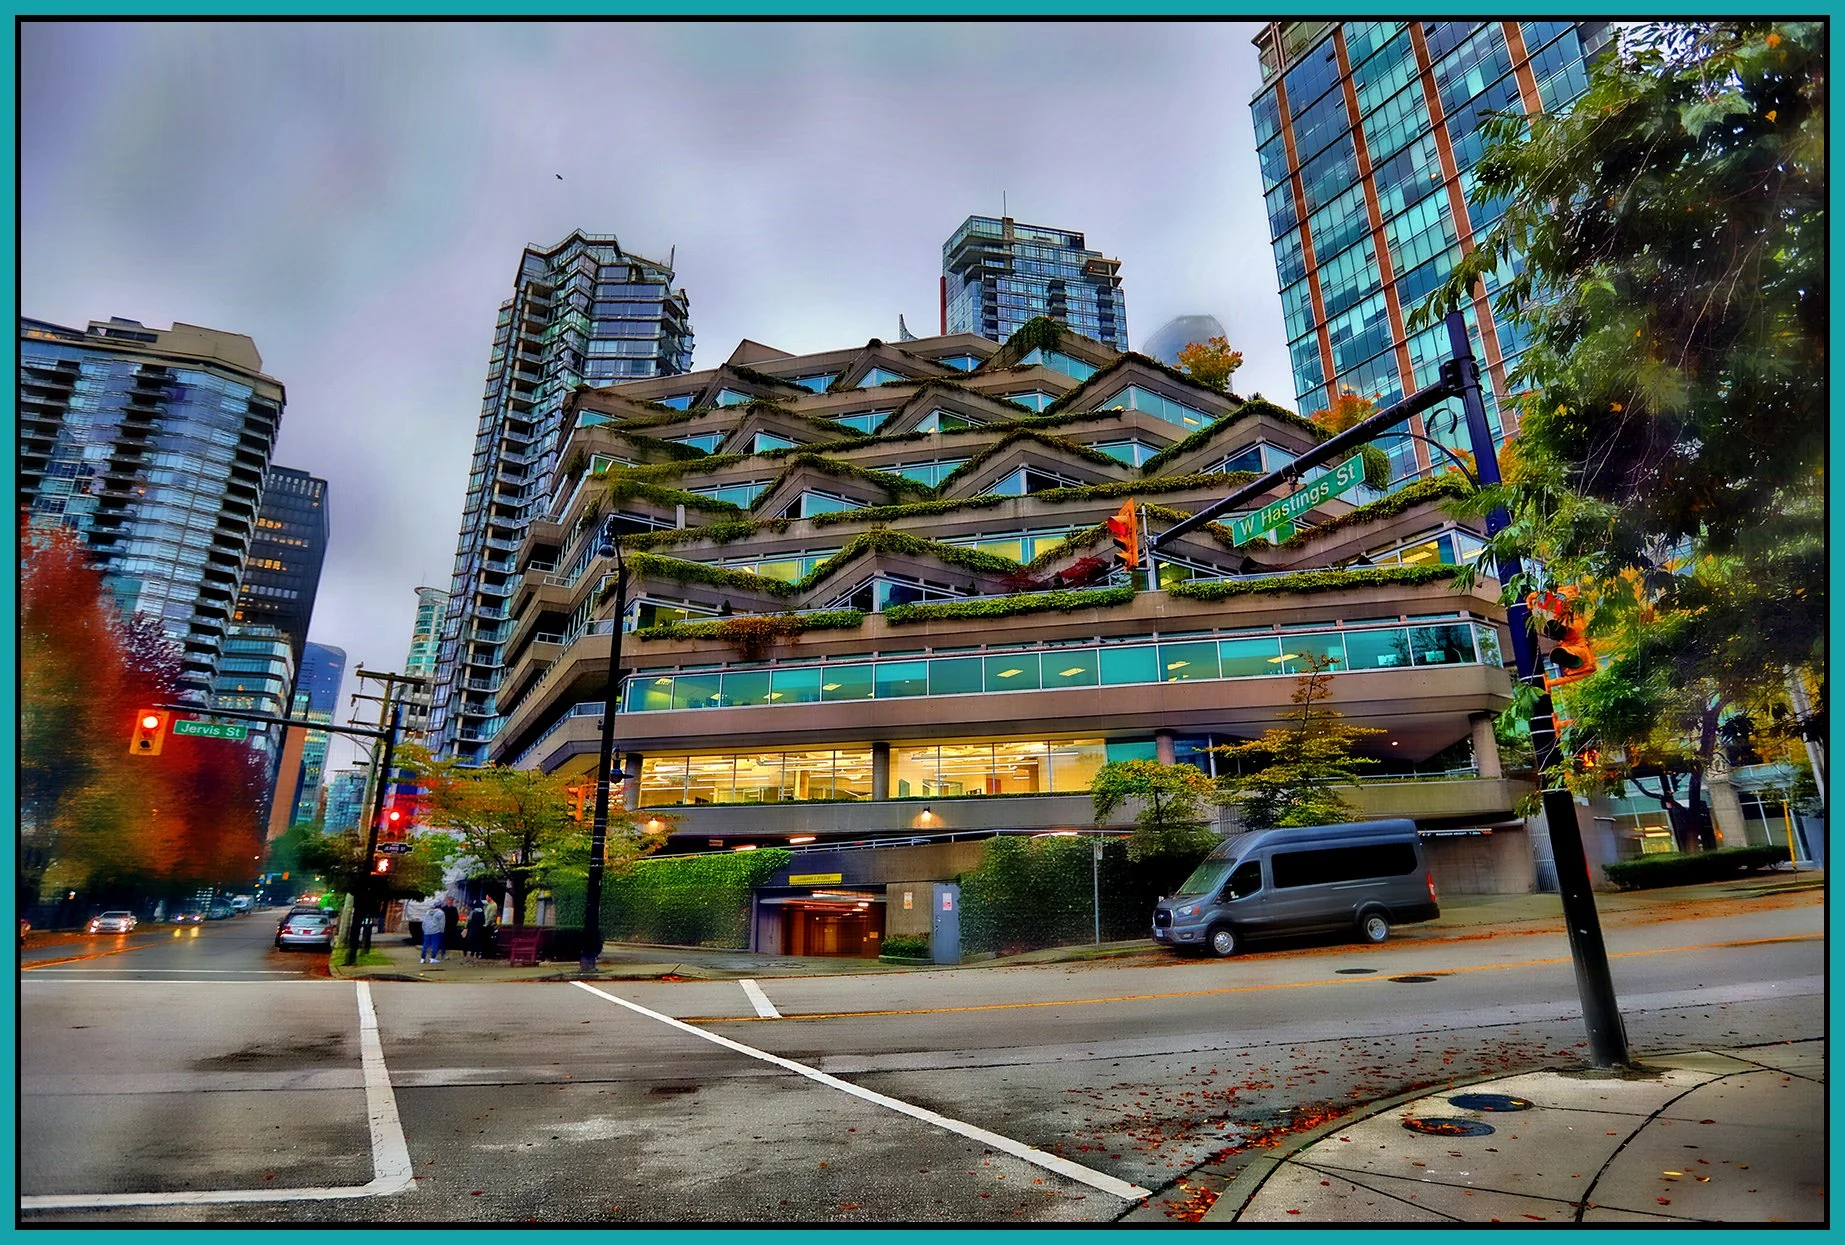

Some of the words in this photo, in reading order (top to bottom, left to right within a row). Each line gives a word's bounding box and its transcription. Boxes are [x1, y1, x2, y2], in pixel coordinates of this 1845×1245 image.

[1239, 517, 1254, 536] W
[1261, 481, 1329, 527] Hastings
[1336, 463, 1355, 486] St
[181, 723, 220, 736] Jervis
[225, 728, 240, 737] St
